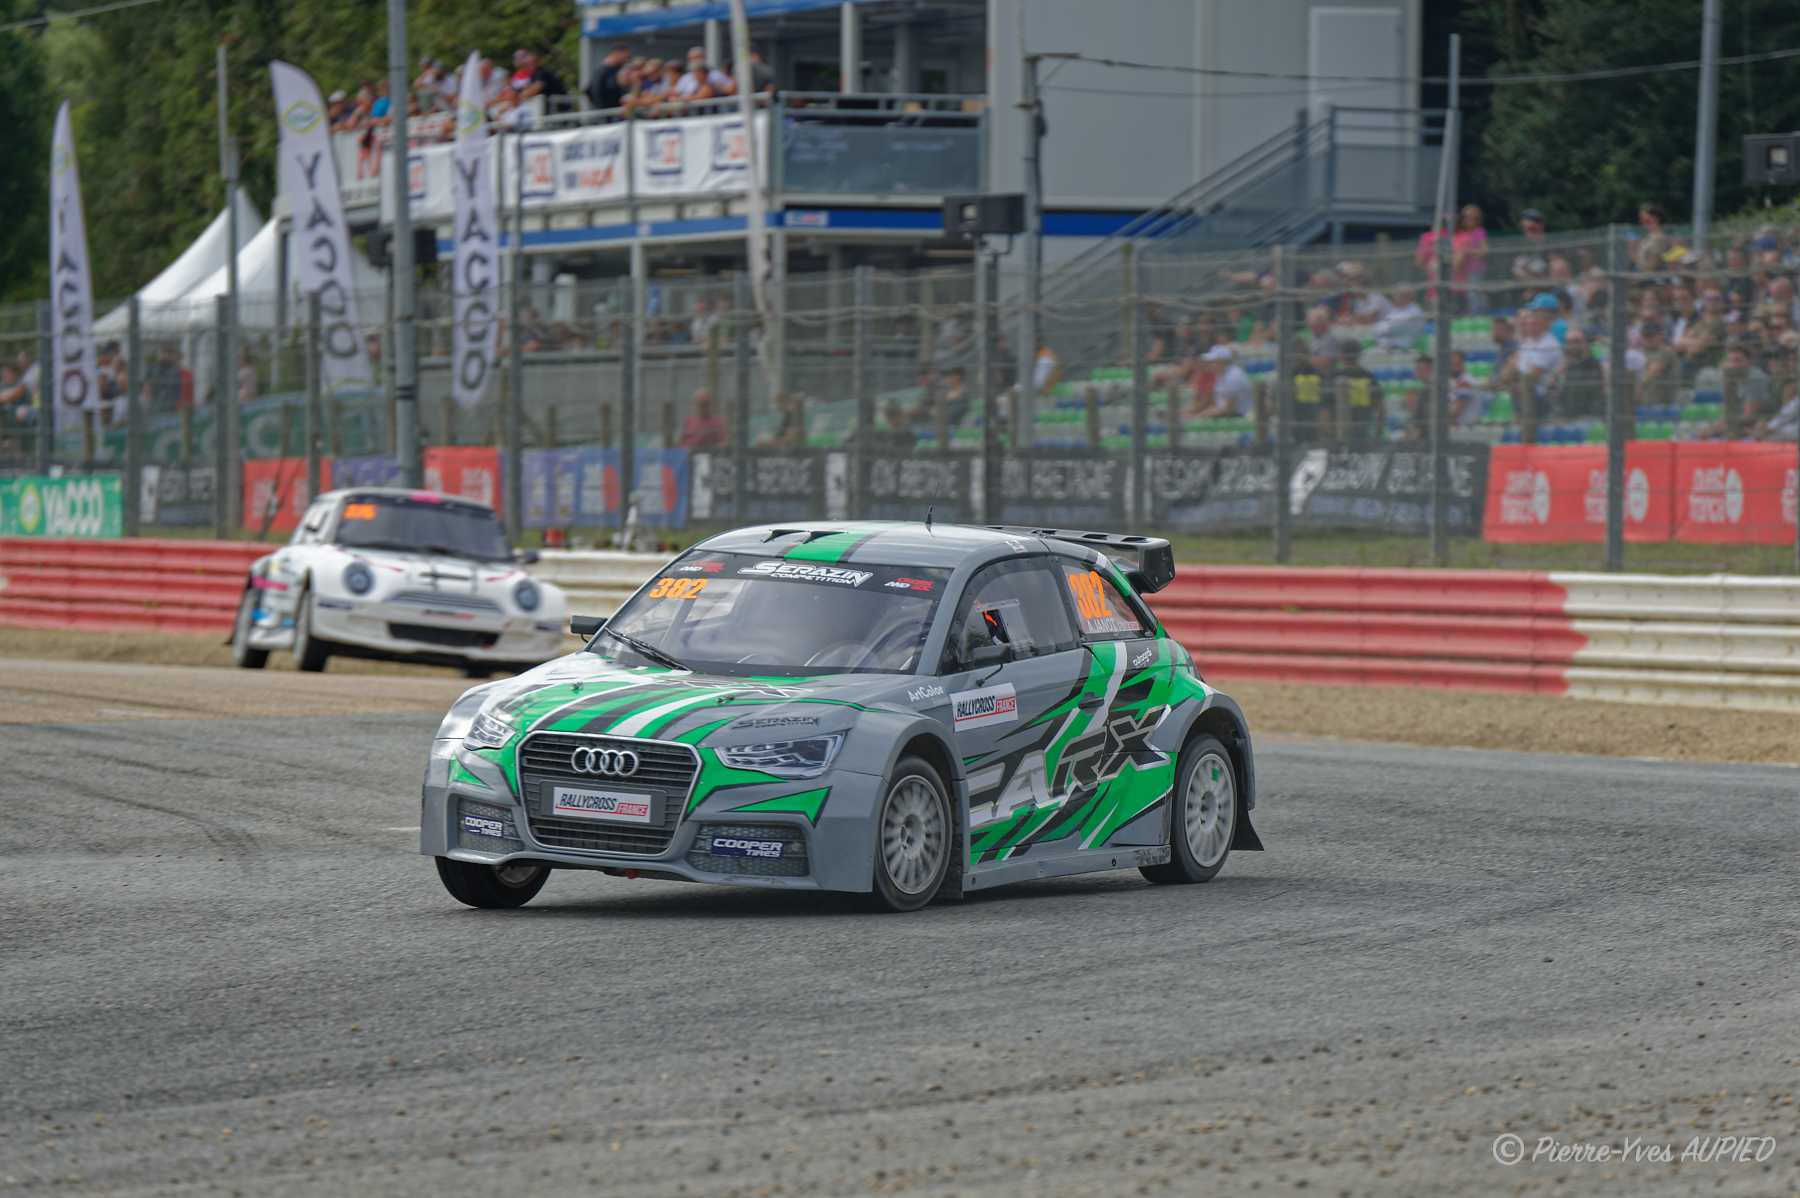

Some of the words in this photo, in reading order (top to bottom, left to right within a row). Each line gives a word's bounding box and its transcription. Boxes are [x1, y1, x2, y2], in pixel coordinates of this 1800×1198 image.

[455, 157, 491, 391] YACCO
[42, 480, 105, 535] YACCO
[737, 561, 873, 588] SERAZIN
[771, 573, 850, 586] COMPETITION
[650, 577, 708, 599] 382
[907, 684, 944, 703] ArtColor
[956, 696, 996, 718] RALLYCROSS
[559, 793, 617, 811] RALLYCROSS
[465, 817, 503, 830] COOPER
[713, 838, 783, 851] COOPER
[745, 849, 781, 858] TIRES
